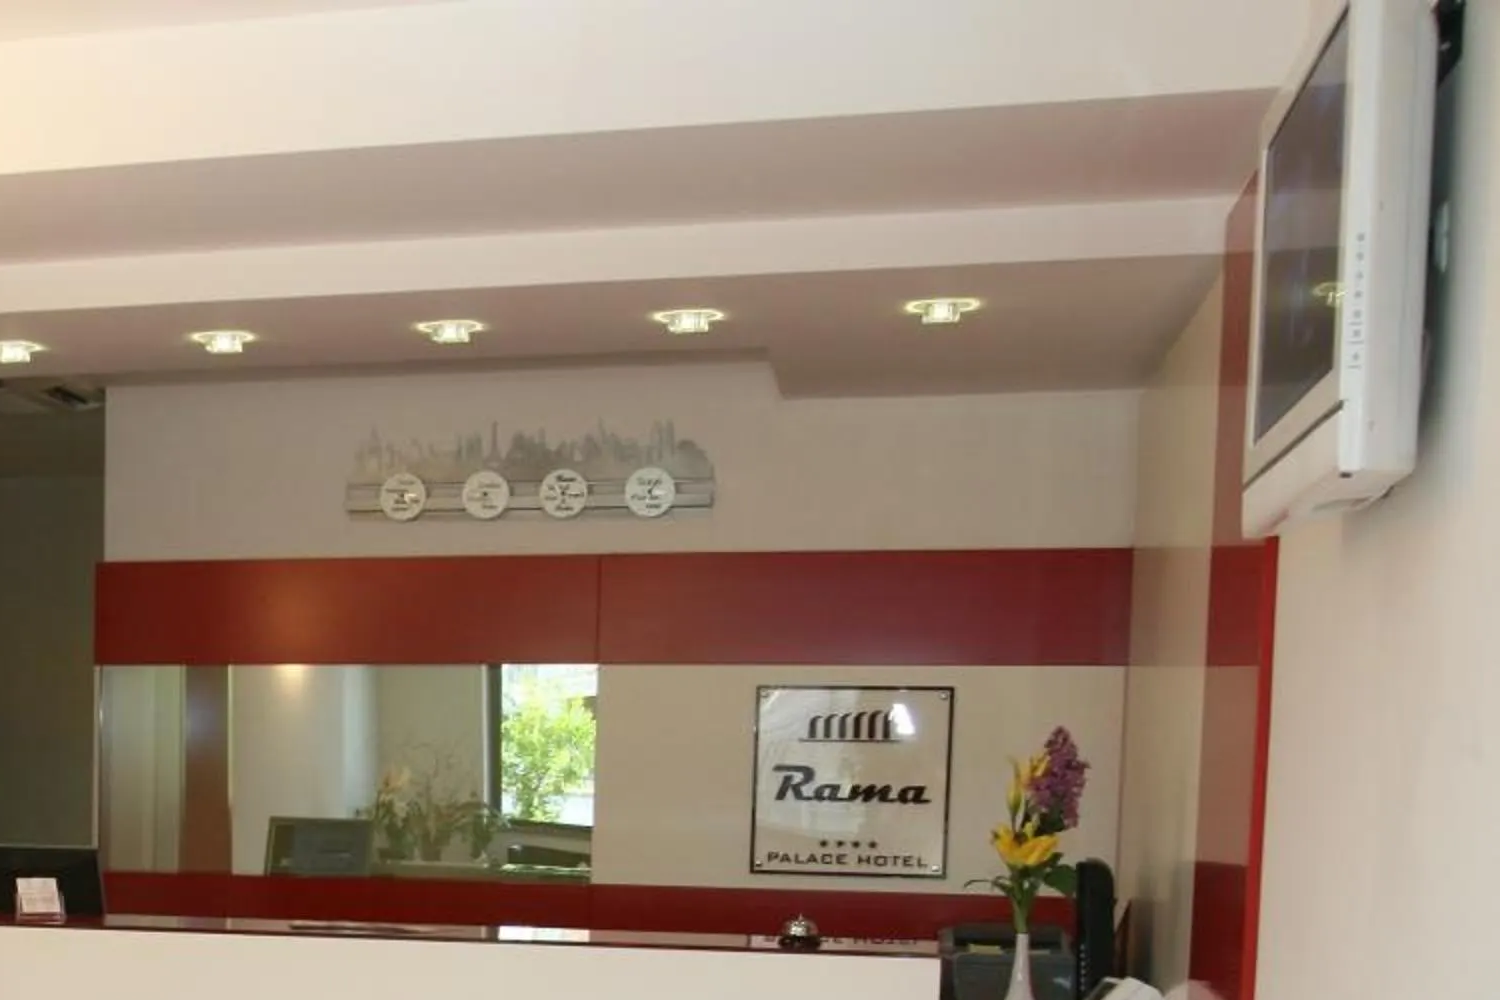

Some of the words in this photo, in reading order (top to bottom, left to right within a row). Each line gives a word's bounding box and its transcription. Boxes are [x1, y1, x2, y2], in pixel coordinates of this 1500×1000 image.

[772, 764, 932, 804] Rama
[766, 851, 848, 866] PALACE
[857, 855, 928, 868] HOTEL
